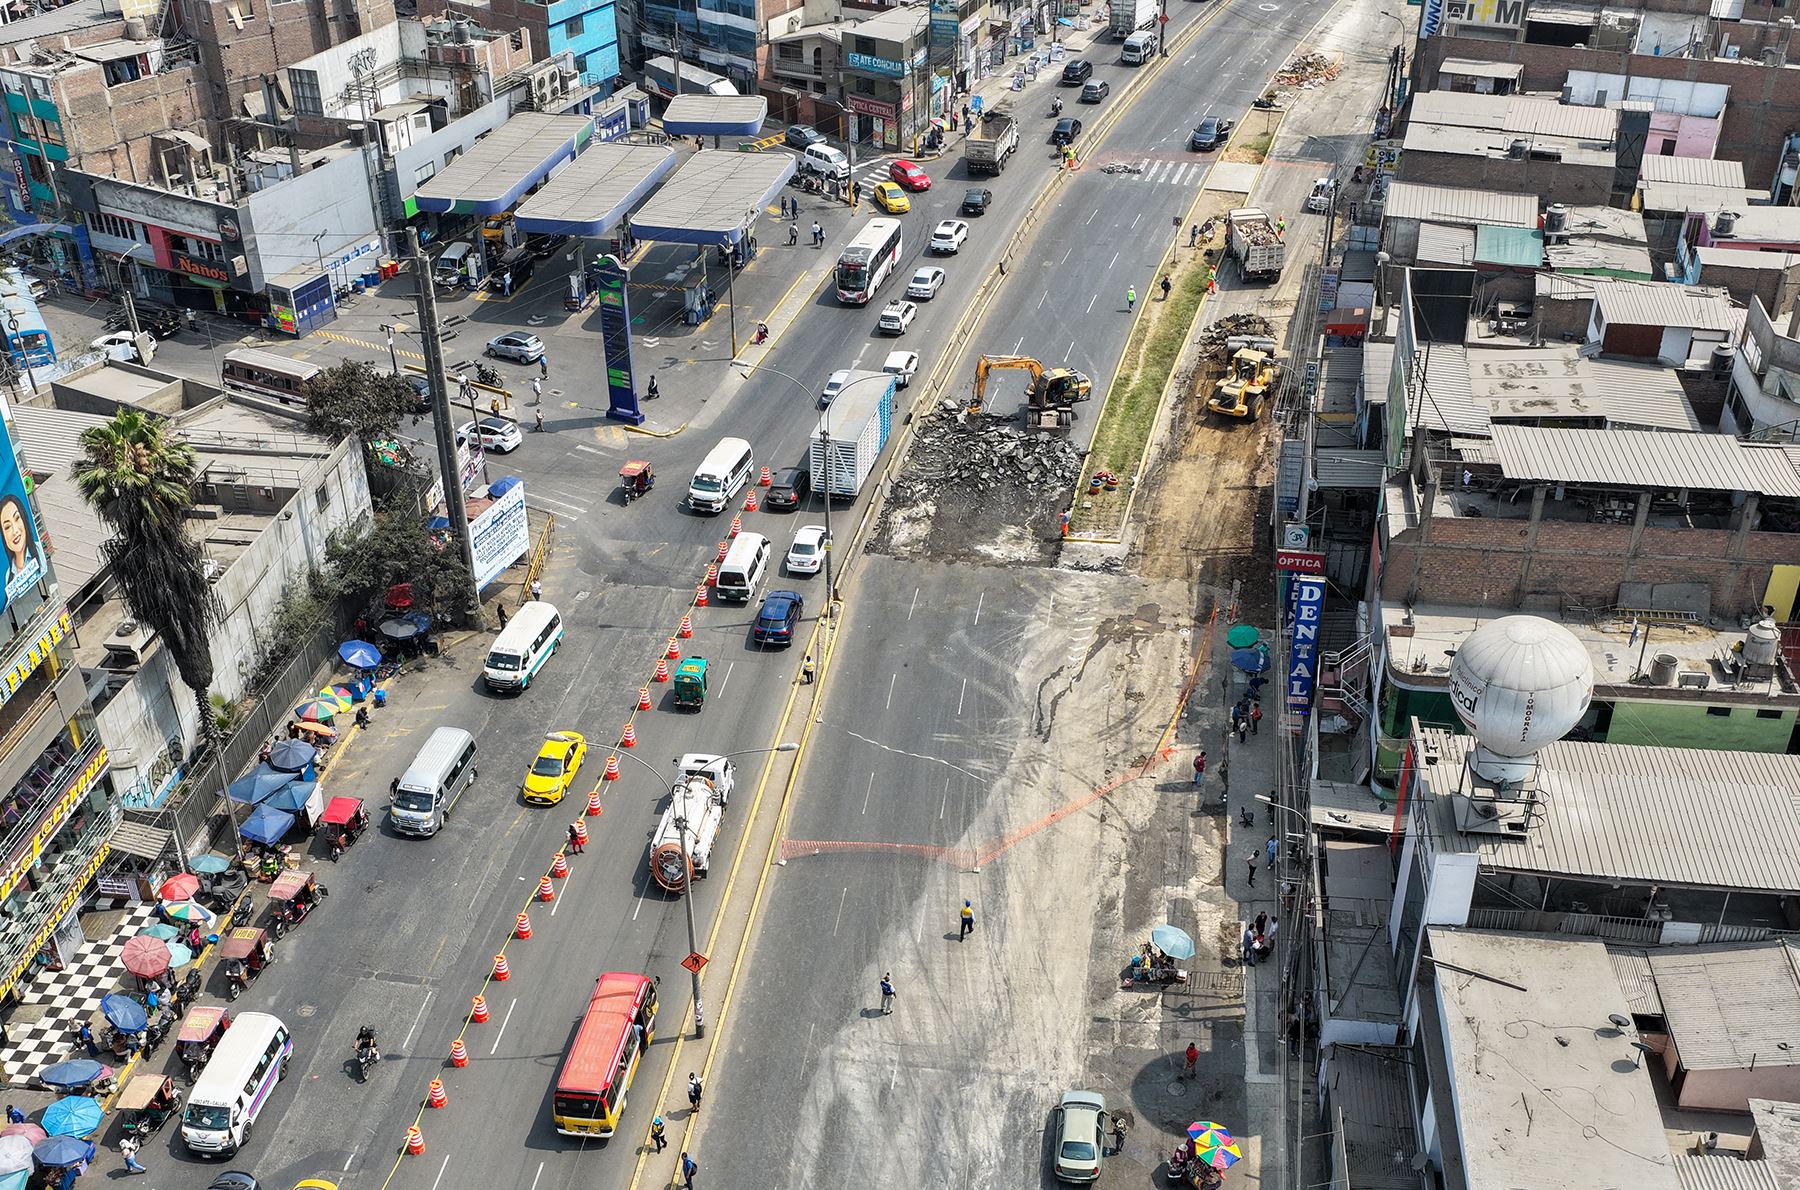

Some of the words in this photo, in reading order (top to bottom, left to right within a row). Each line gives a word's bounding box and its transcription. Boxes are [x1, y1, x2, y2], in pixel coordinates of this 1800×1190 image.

[14, 160, 28, 195] BOTICA
[1305, 366, 1315, 400] DENTAL
[1278, 556, 1321, 568] ÓPTICA
[6, 613, 70, 695] PLANET
[1290, 586, 1321, 696] DENTAL
[61, 842, 111, 912] CELULARES
